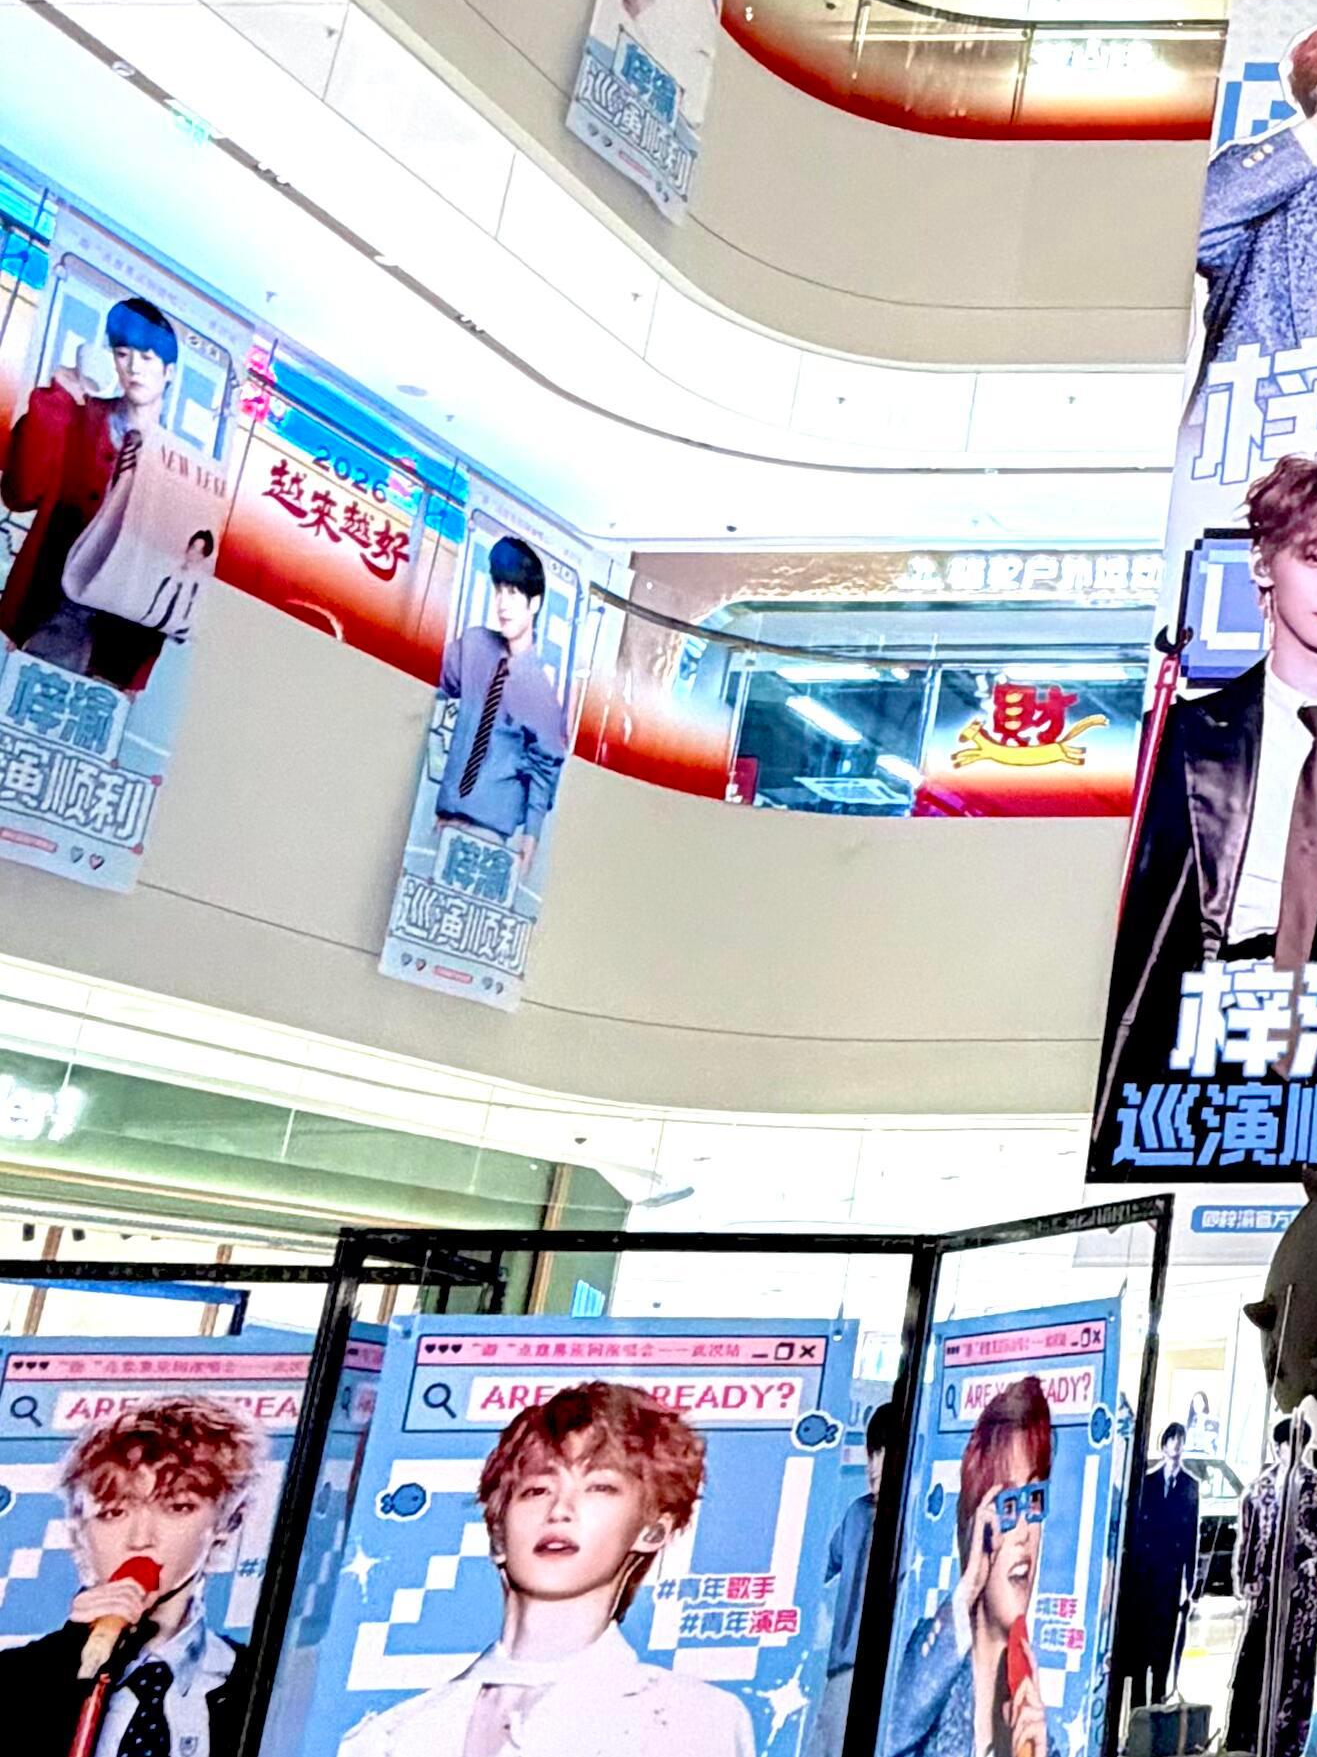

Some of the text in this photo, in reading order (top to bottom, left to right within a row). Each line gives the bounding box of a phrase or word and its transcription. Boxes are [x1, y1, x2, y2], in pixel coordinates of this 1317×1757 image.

[314, 446, 388, 505] 2026
[263, 459, 411, 581] 越来越好
[394, 877, 533, 974] 巡演顺利
[480, 1384, 555, 1411] ARE
[657, 1575, 776, 1600] #青年歌手
[679, 1608, 798, 1634] #青年演员
